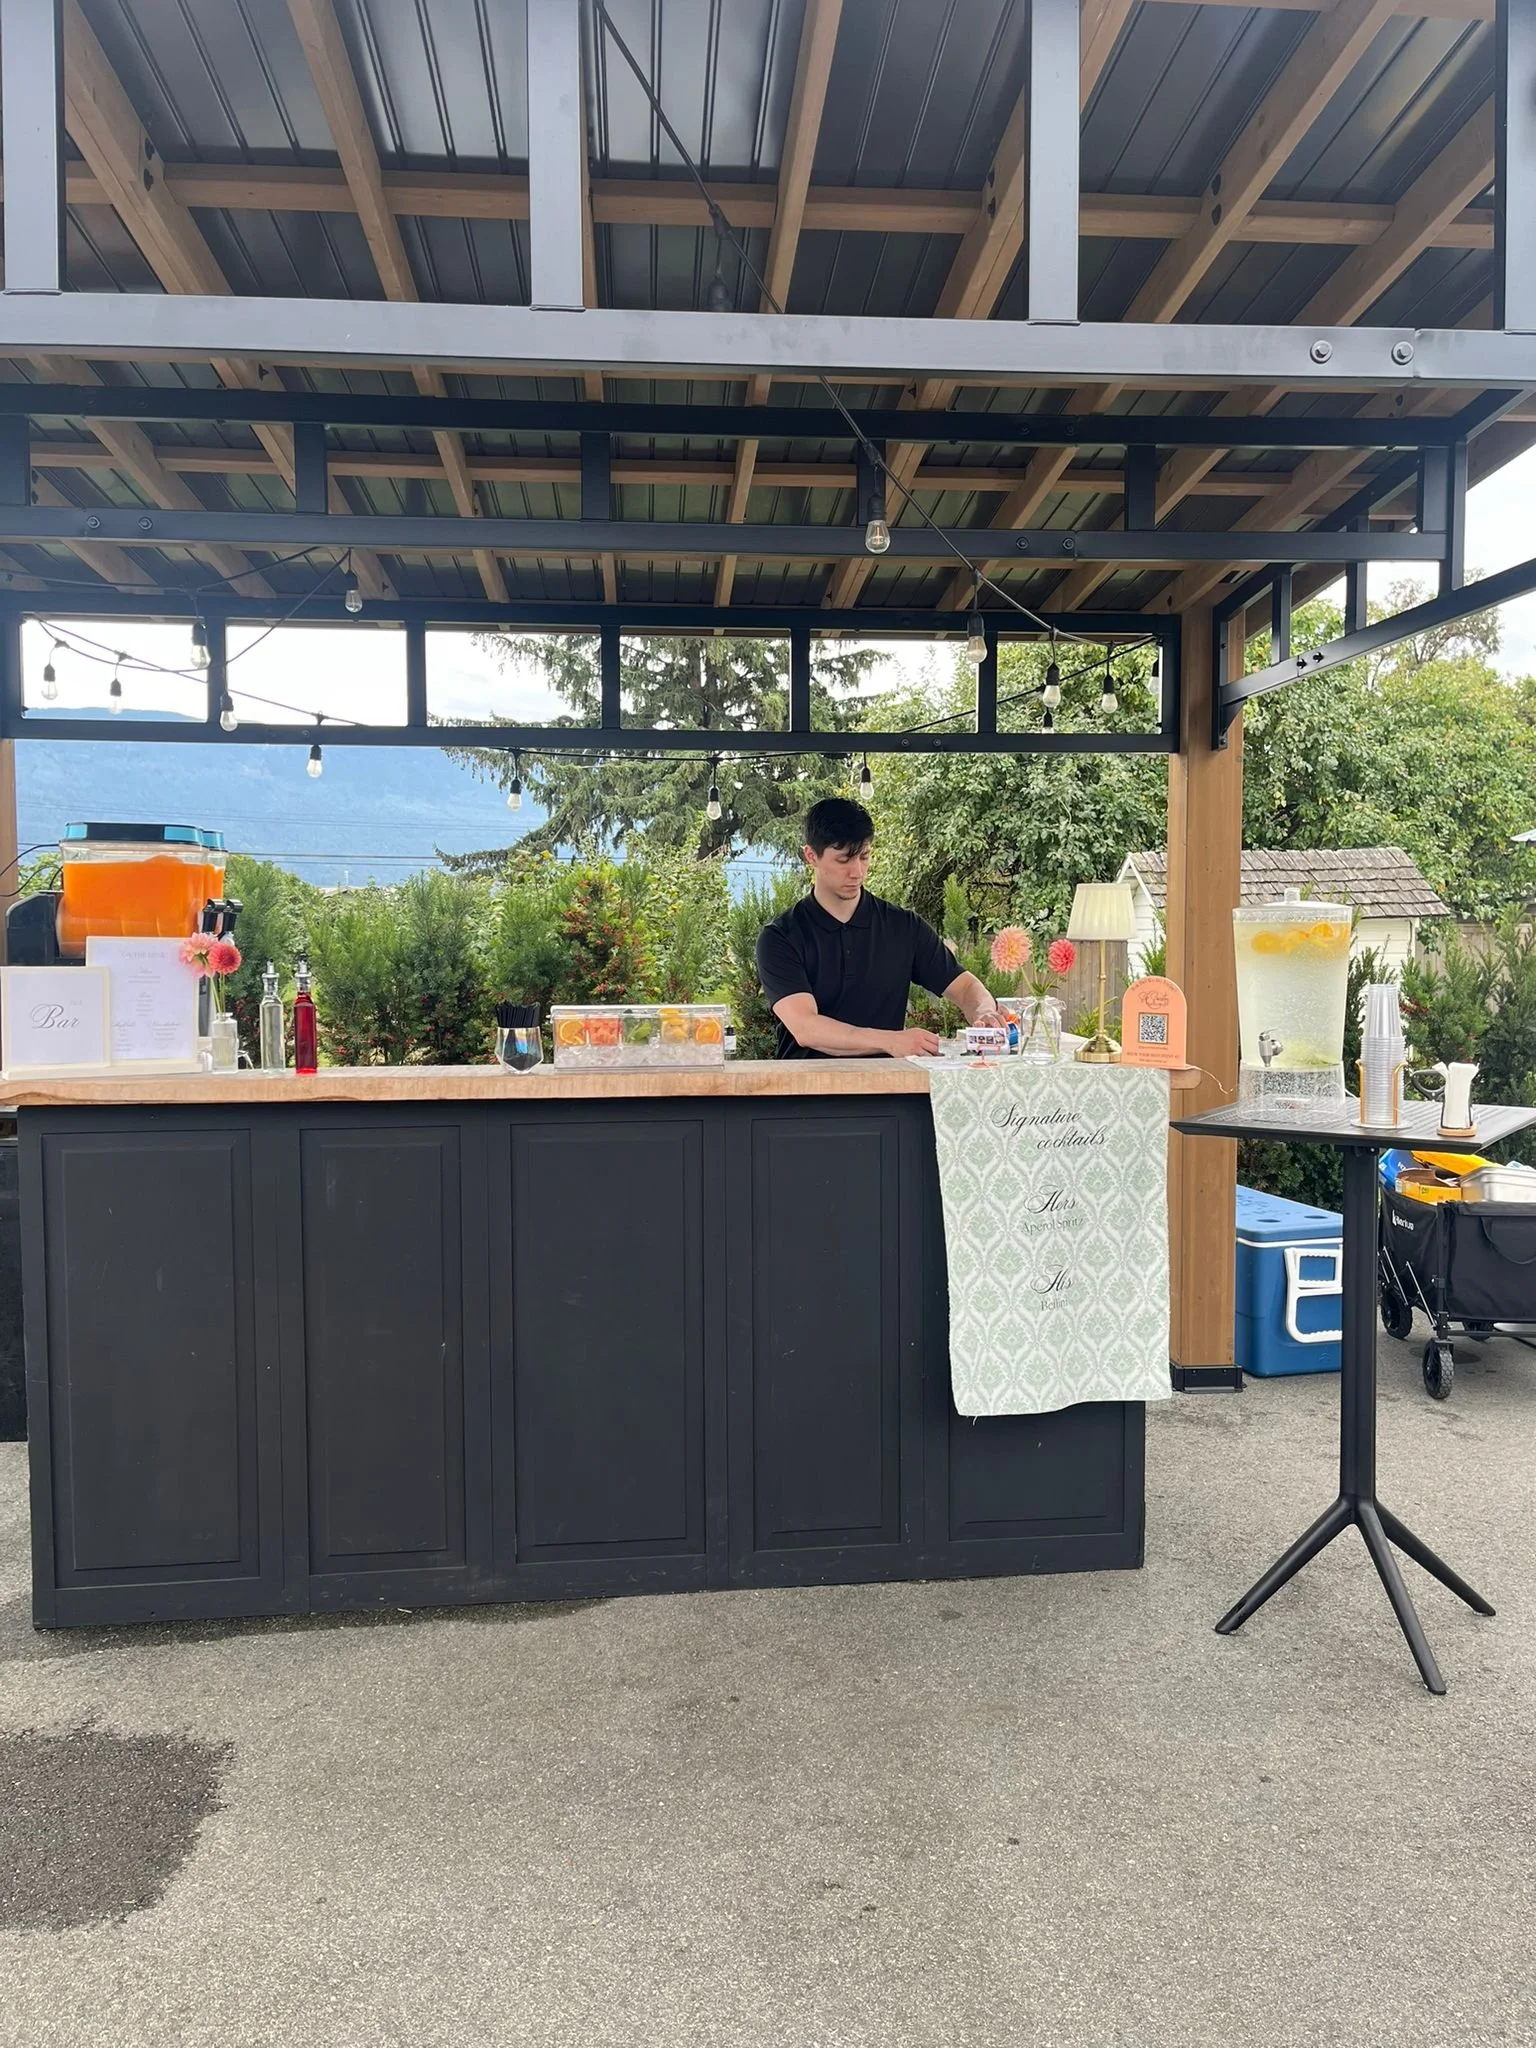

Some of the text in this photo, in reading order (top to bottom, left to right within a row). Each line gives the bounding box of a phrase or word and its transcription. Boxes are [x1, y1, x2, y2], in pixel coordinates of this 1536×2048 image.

[29, 1003, 81, 1029] Bar
[990, 1103, 1082, 1136] Signature
[1037, 1125, 1108, 1149] cocktails
[1024, 1184, 1077, 1214] Hers
[1022, 1217, 1084, 1235] Aperol Spritz
[1030, 1264, 1072, 1294] His
